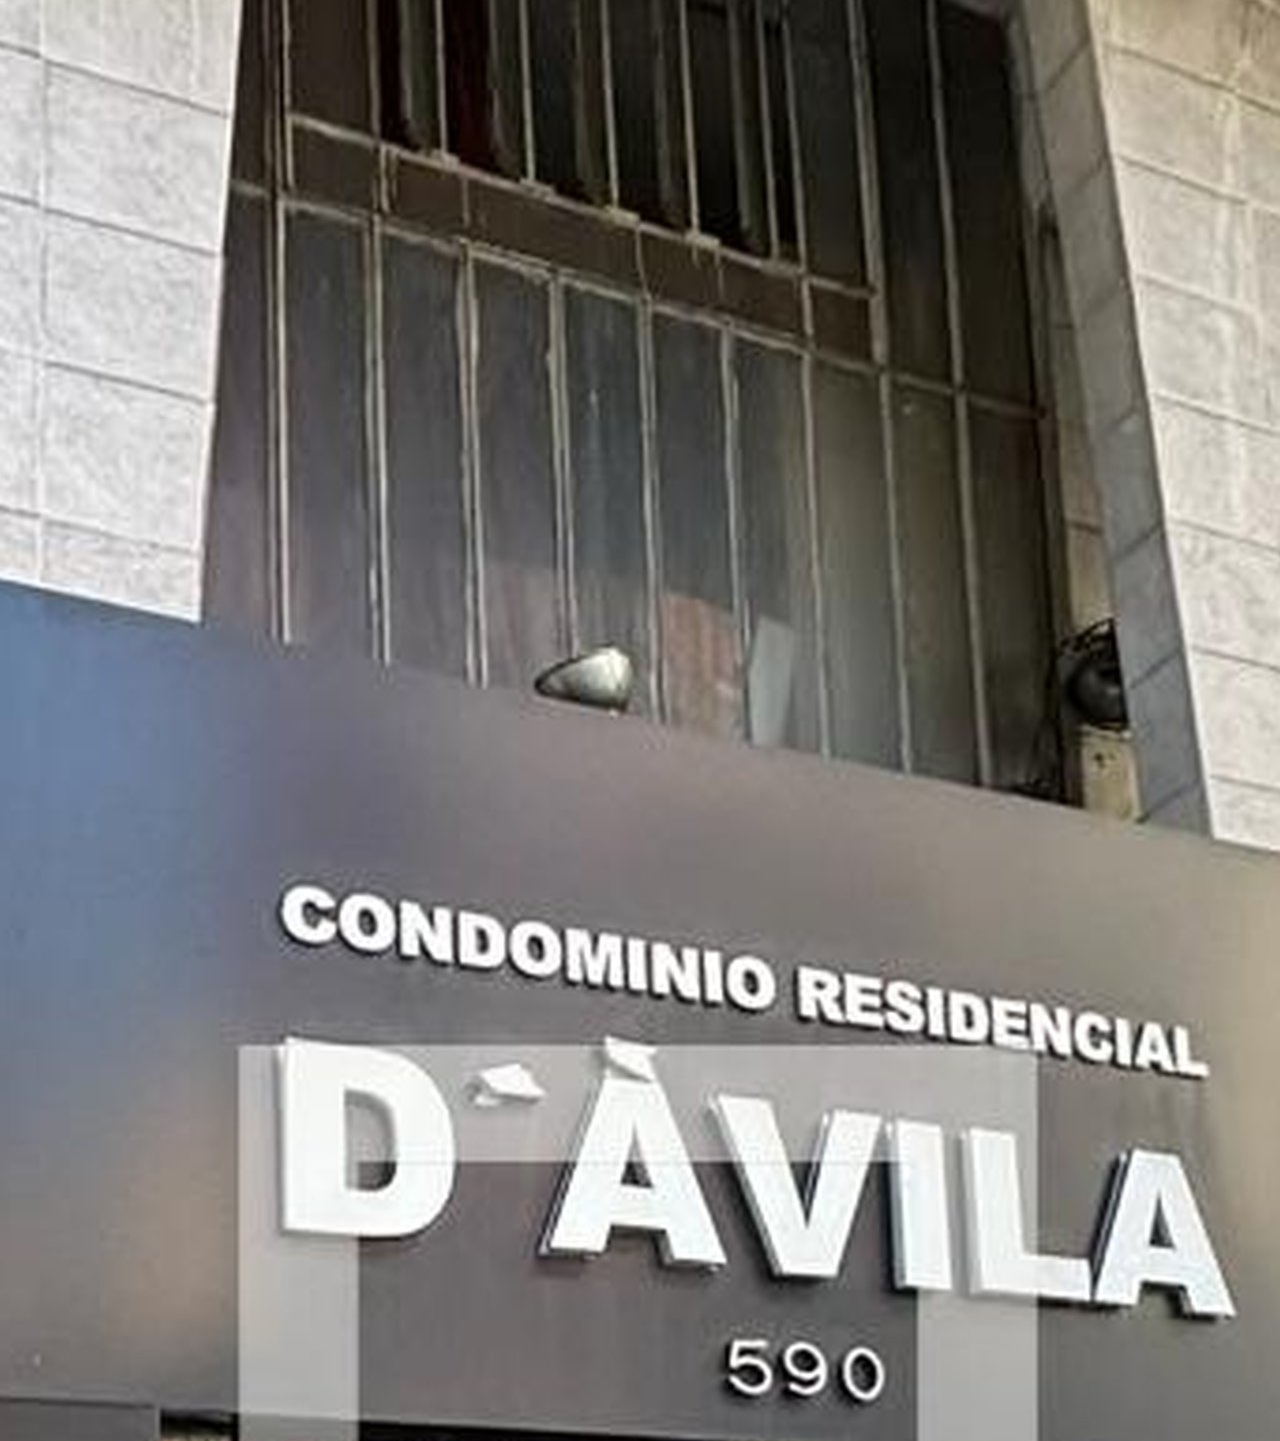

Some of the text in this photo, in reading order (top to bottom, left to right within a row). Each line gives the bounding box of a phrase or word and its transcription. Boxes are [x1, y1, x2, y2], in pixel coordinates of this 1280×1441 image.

[281, 885, 1209, 1078] CONDOMINIO RESIDENCIAL
[726, 1339, 886, 1403] 590
